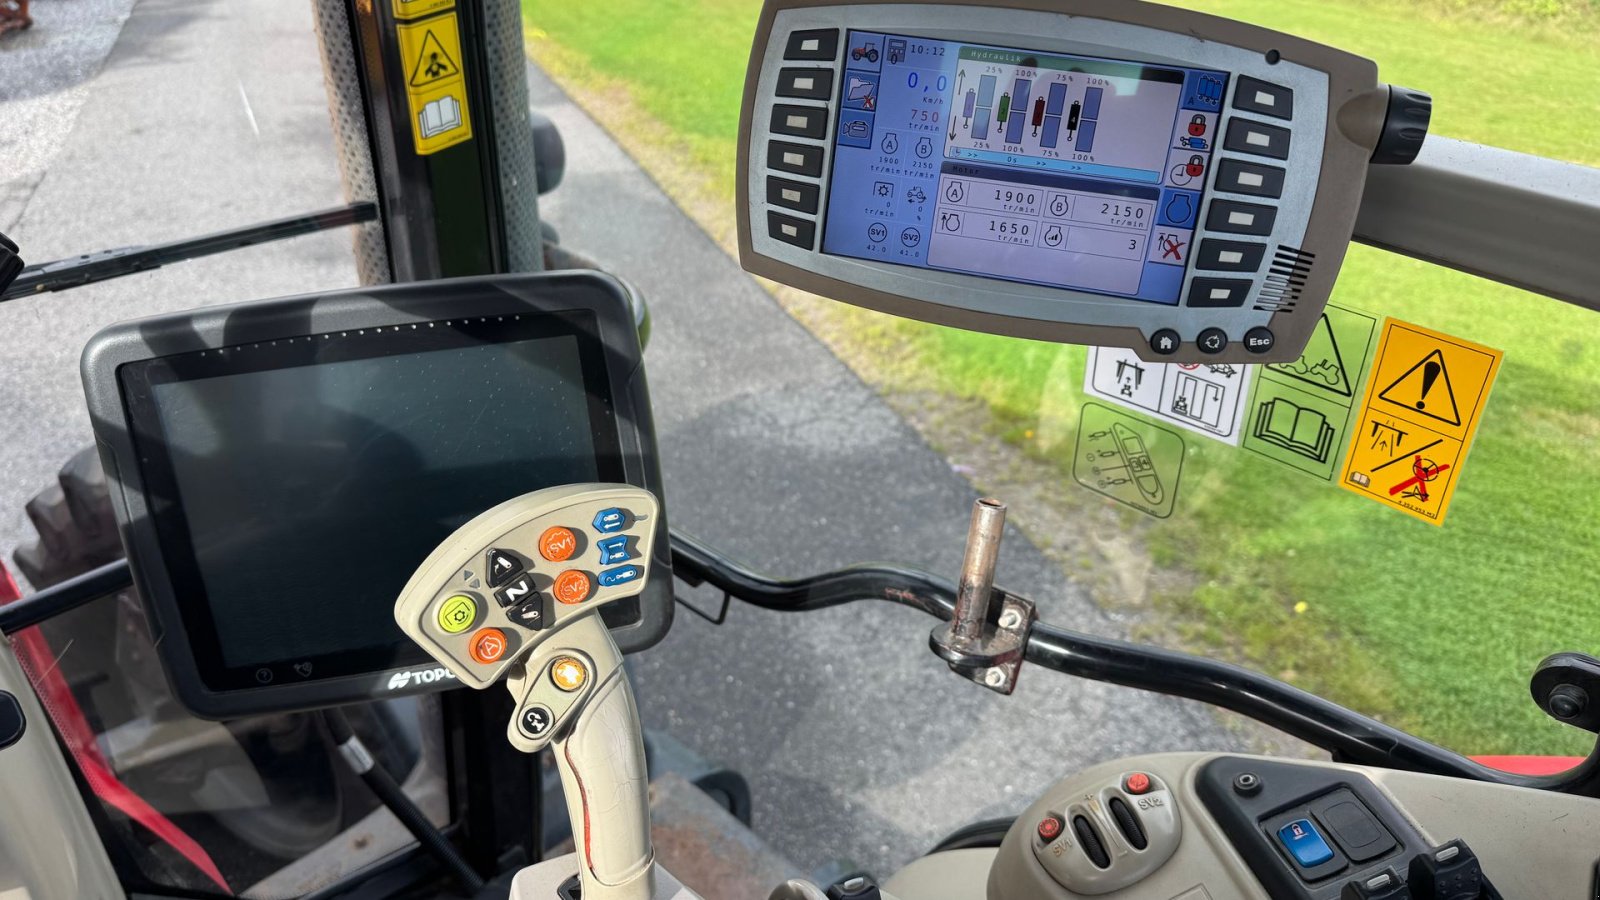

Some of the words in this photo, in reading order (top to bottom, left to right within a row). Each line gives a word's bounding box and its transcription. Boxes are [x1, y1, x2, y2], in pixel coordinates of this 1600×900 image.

[911, 44, 945, 57] 10:12
[970, 50, 1022, 63] Hydraulik
[985, 65, 1003, 74] 25%
[1015, 69, 1038, 78] 100%
[1056, 73, 1074, 82] 75%
[1086, 77, 1110, 86] 100%
[907, 72, 947, 92] 0,0
[922, 96, 944, 105] Km/h
[910, 109, 939, 123] 750
[908, 122, 940, 132] tr/min
[973, 141, 990, 149] 25%
[1002, 144, 1024, 153] 100%
[1042, 149, 1060, 158] 75%
[1072, 153, 1095, 162] 100%
[879, 156, 899, 165] 1900
[912, 160, 933, 170] 2150
[870, 165, 900, 175] tr/min
[904, 169, 935, 179] tr/min
[952, 165, 980, 175] Motor
[951, 188, 958, 198] A
[994, 189, 1035, 205] 1900
[864, 207, 894, 217] tr/min
[1003, 203, 1036, 214] tr/min
[1055, 202, 1063, 212] B
[1100, 203, 1144, 219] 2150
[989, 220, 1030, 236] 1650
[1110, 218, 1144, 228] tr/min
[870, 229, 885, 237] SV1
[903, 233, 919, 242] SV2
[997, 234, 1030, 244] tr/min
[866, 244, 886, 253] 42.0
[1128, 240, 1137, 250] 3
[1249, 338, 1270, 346] Esc
[549, 537, 573, 554] SV1
[563, 579, 585, 595] SV2
[483, 638, 498, 656] A
[411, 667, 456, 685] TOPC
[1137, 798, 1164, 811] SV2
[1052, 839, 1073, 857] SV1
